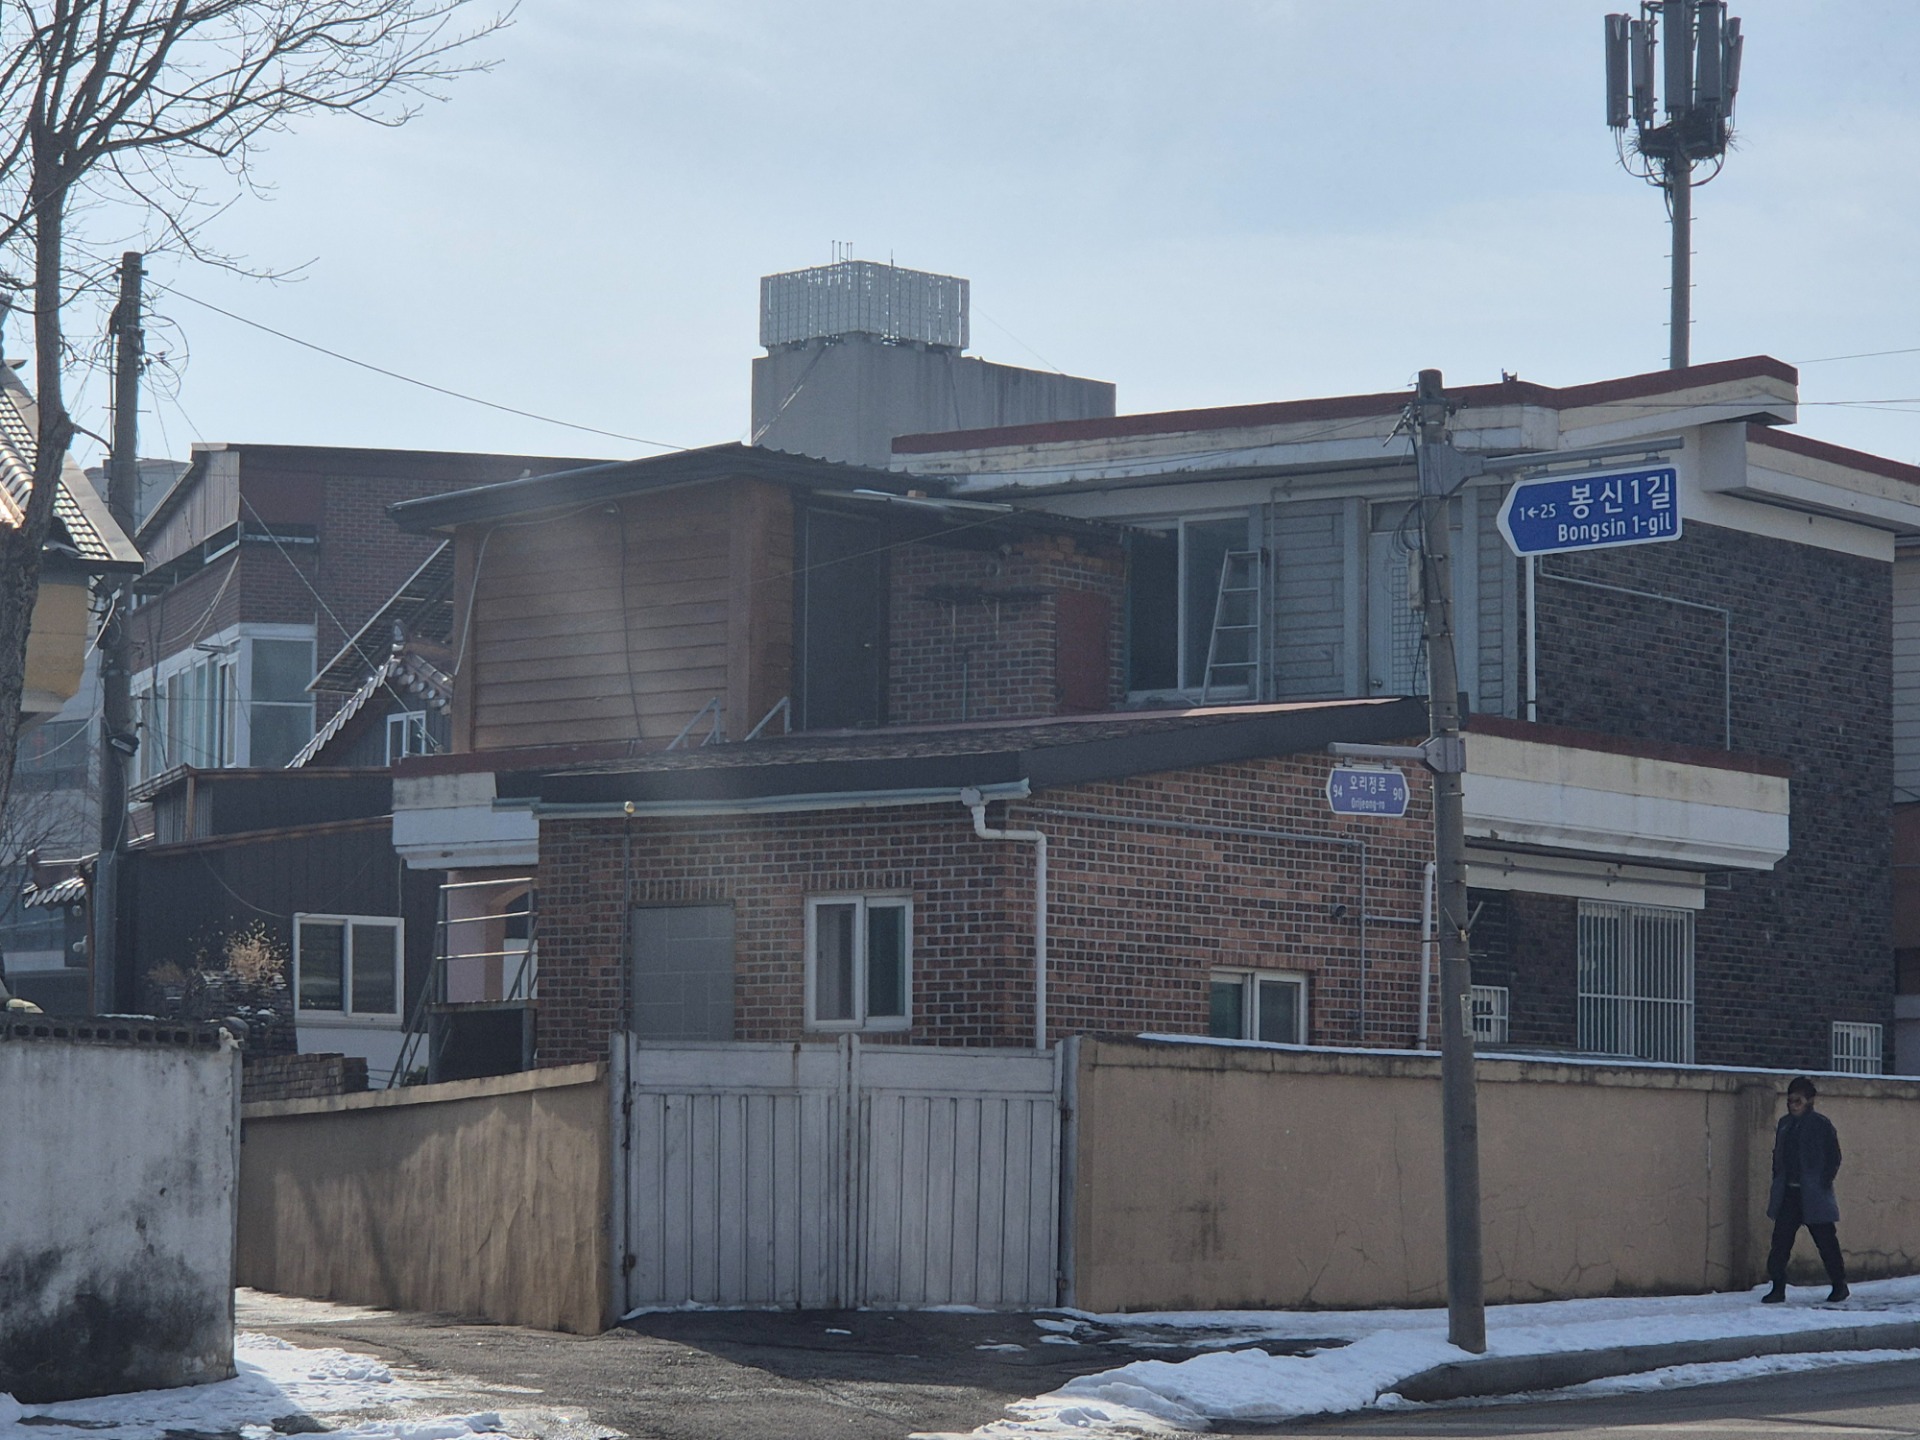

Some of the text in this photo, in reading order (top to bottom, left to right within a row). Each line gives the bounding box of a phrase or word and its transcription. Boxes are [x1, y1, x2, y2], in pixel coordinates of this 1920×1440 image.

[1568, 474, 1671, 519] 봉신1길
[1558, 512, 1671, 542] Bongsin 1-gil
[1333, 784, 1343, 798] 94
[1350, 775, 1387, 794] 오리정로
[1393, 787, 1403, 801] 90
